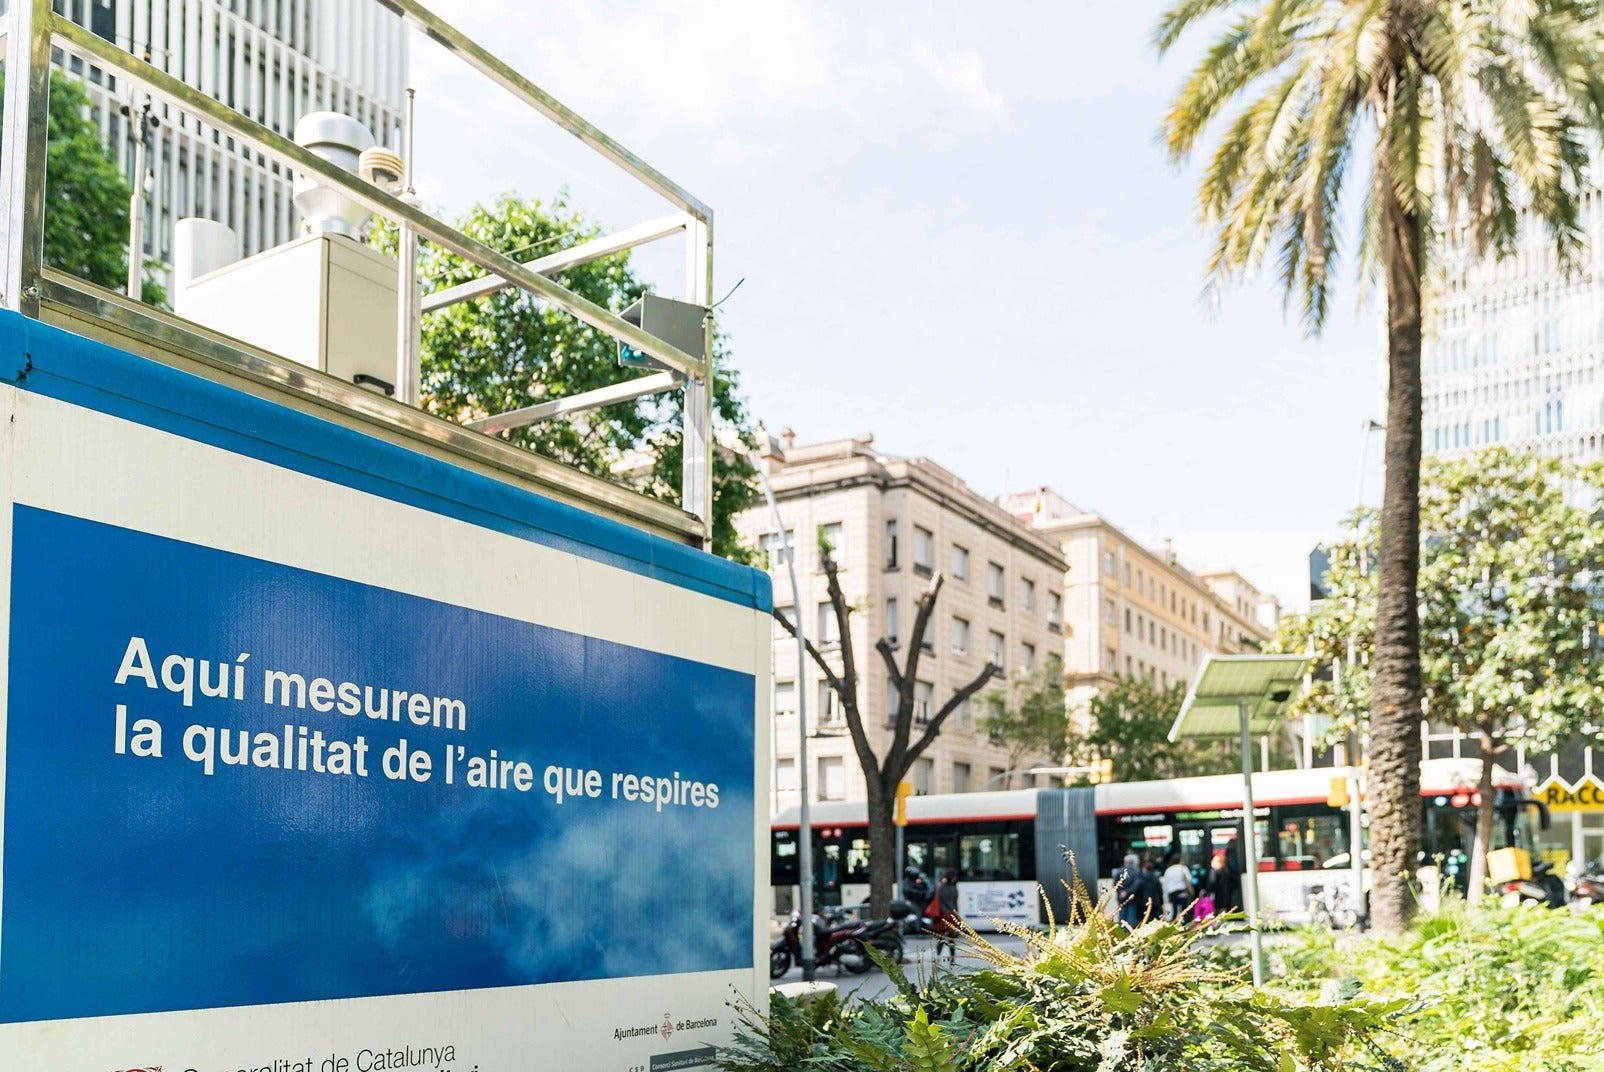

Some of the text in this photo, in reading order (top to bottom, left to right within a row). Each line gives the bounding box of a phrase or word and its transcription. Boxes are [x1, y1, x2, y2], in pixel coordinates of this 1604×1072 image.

[114, 636, 466, 730] Aquí mesurem
[114, 704, 163, 758] la
[182, 722, 369, 775] qualitat
[382, 738, 432, 782] de
[543, 765, 602, 805] que
[611, 771, 720, 812] respires
[1547, 786, 1604, 804] RACC
[613, 1018, 717, 1041] Ajuntament de Barcelona
[321, 1053, 349, 1072] de
[356, 1044, 456, 1072] Catalunya
